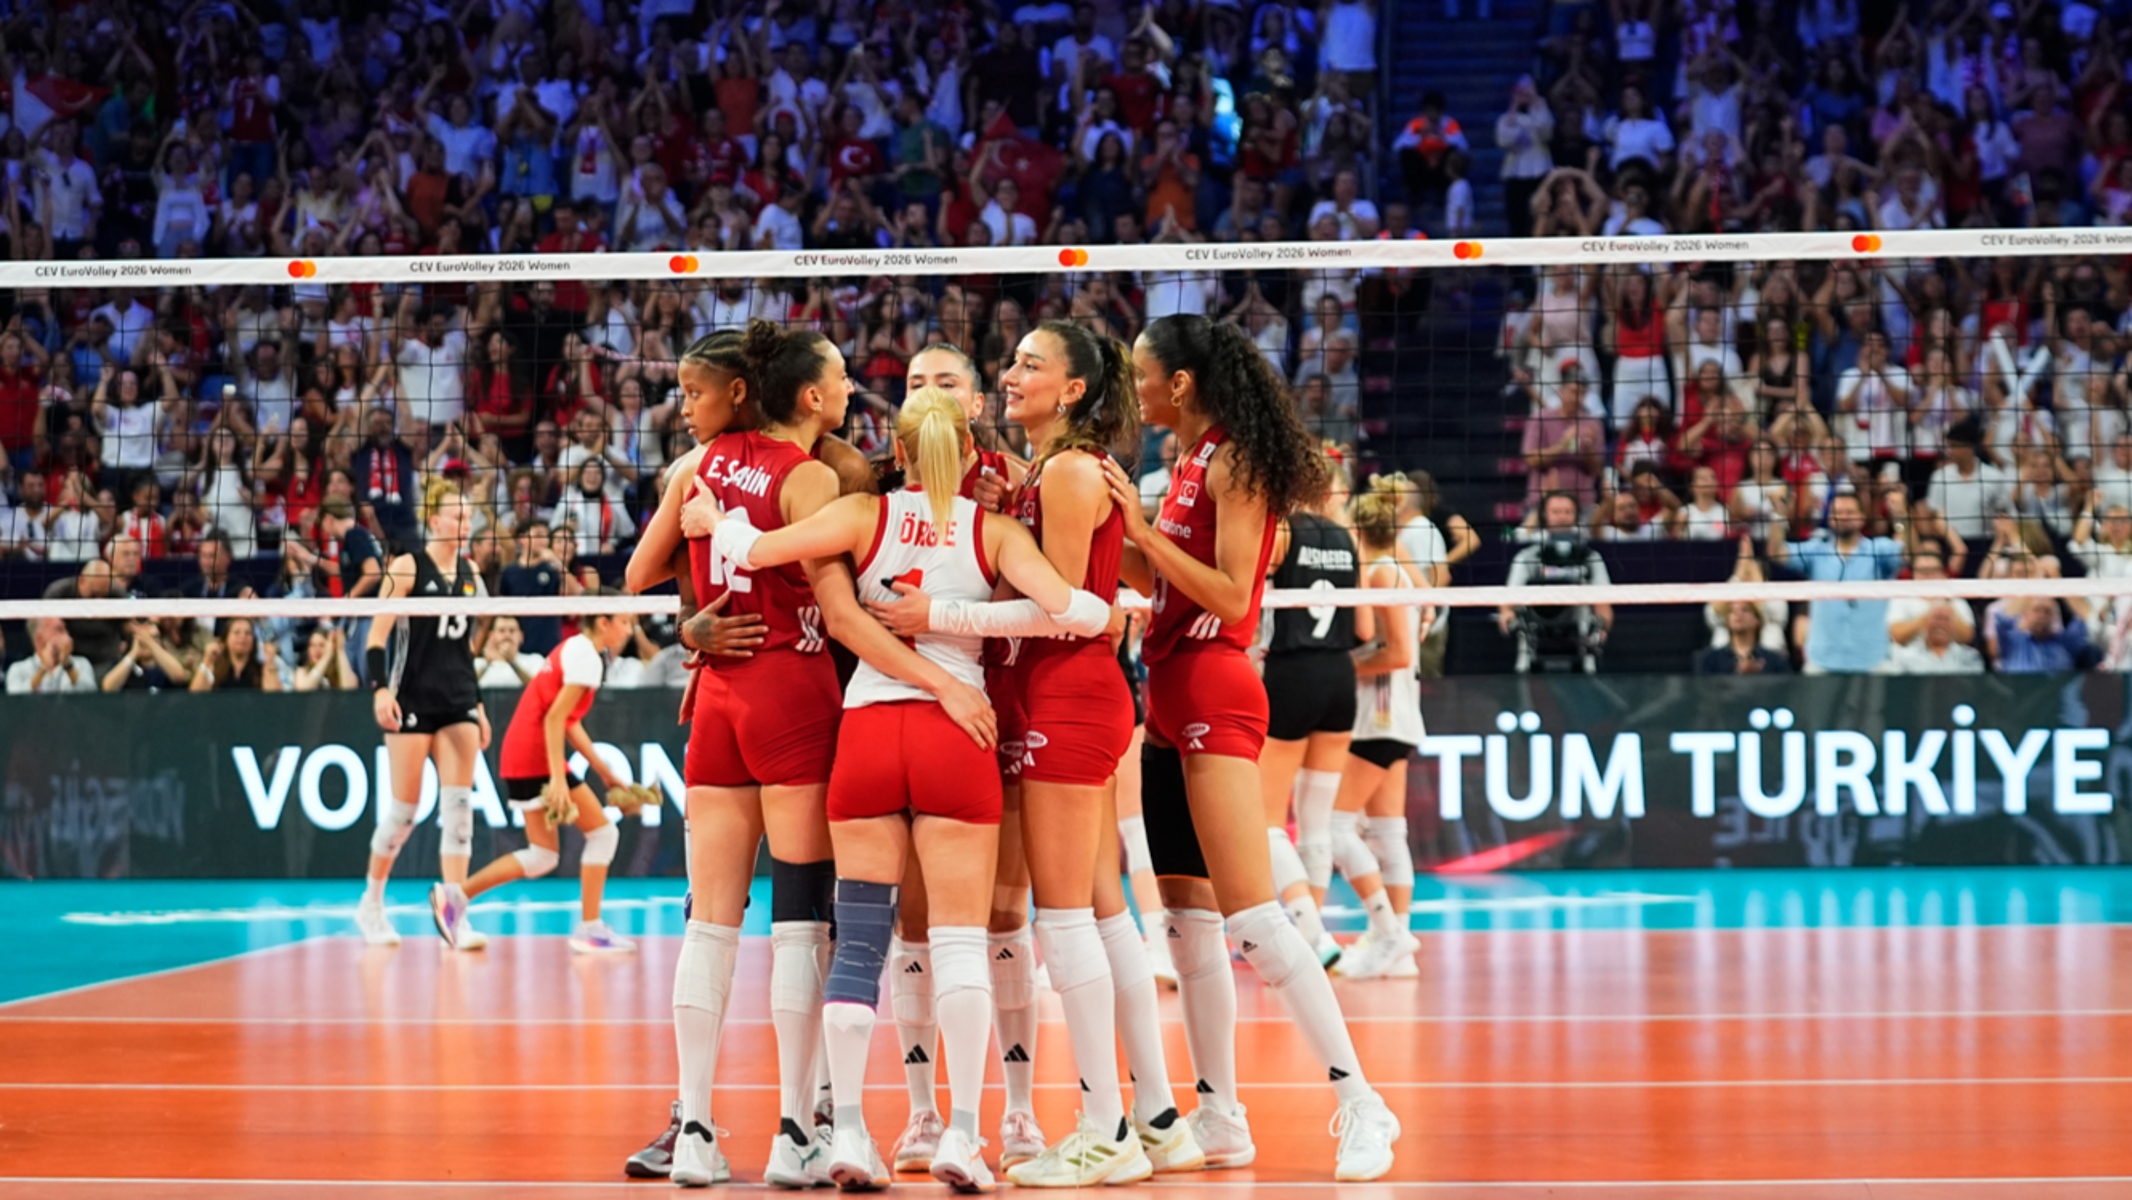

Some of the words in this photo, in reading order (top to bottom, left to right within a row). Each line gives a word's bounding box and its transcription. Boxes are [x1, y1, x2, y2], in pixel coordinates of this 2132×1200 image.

[1581, 241, 1606, 252] CEV
[1609, 240, 1670, 253] EuroVolley
[1673, 240, 1702, 251] 2026
[1705, 239, 1749, 250] Women
[1981, 235, 2006, 246] CEV
[2008, 234, 2070, 247] EuroVolley
[2073, 234, 2101, 245] 2026
[794, 255, 818, 266] CEV
[821, 255, 881, 268] EuroVolley
[884, 254, 912, 265] 2026
[914, 254, 958, 265] Women
[1185, 249, 1210, 260] CEV
[1213, 248, 1273, 261] EuroVolley
[1276, 247, 1305, 259] 2026
[1307, 247, 1352, 258] Women
[35, 266, 58, 277] CEV
[60, 265, 118, 278] EuroVolley
[120, 265, 147, 276] 2026
[150, 265, 192, 275] Women
[409, 262, 433, 273] CEV
[436, 261, 495, 274] EuroVolley
[498, 260, 525, 271] 2026
[528, 260, 571, 271] Women
[1307, 579, 1337, 639] 9
[1418, 711, 1646, 821] TÜM
[1670, 704, 2114, 819] TÜRKİYE
